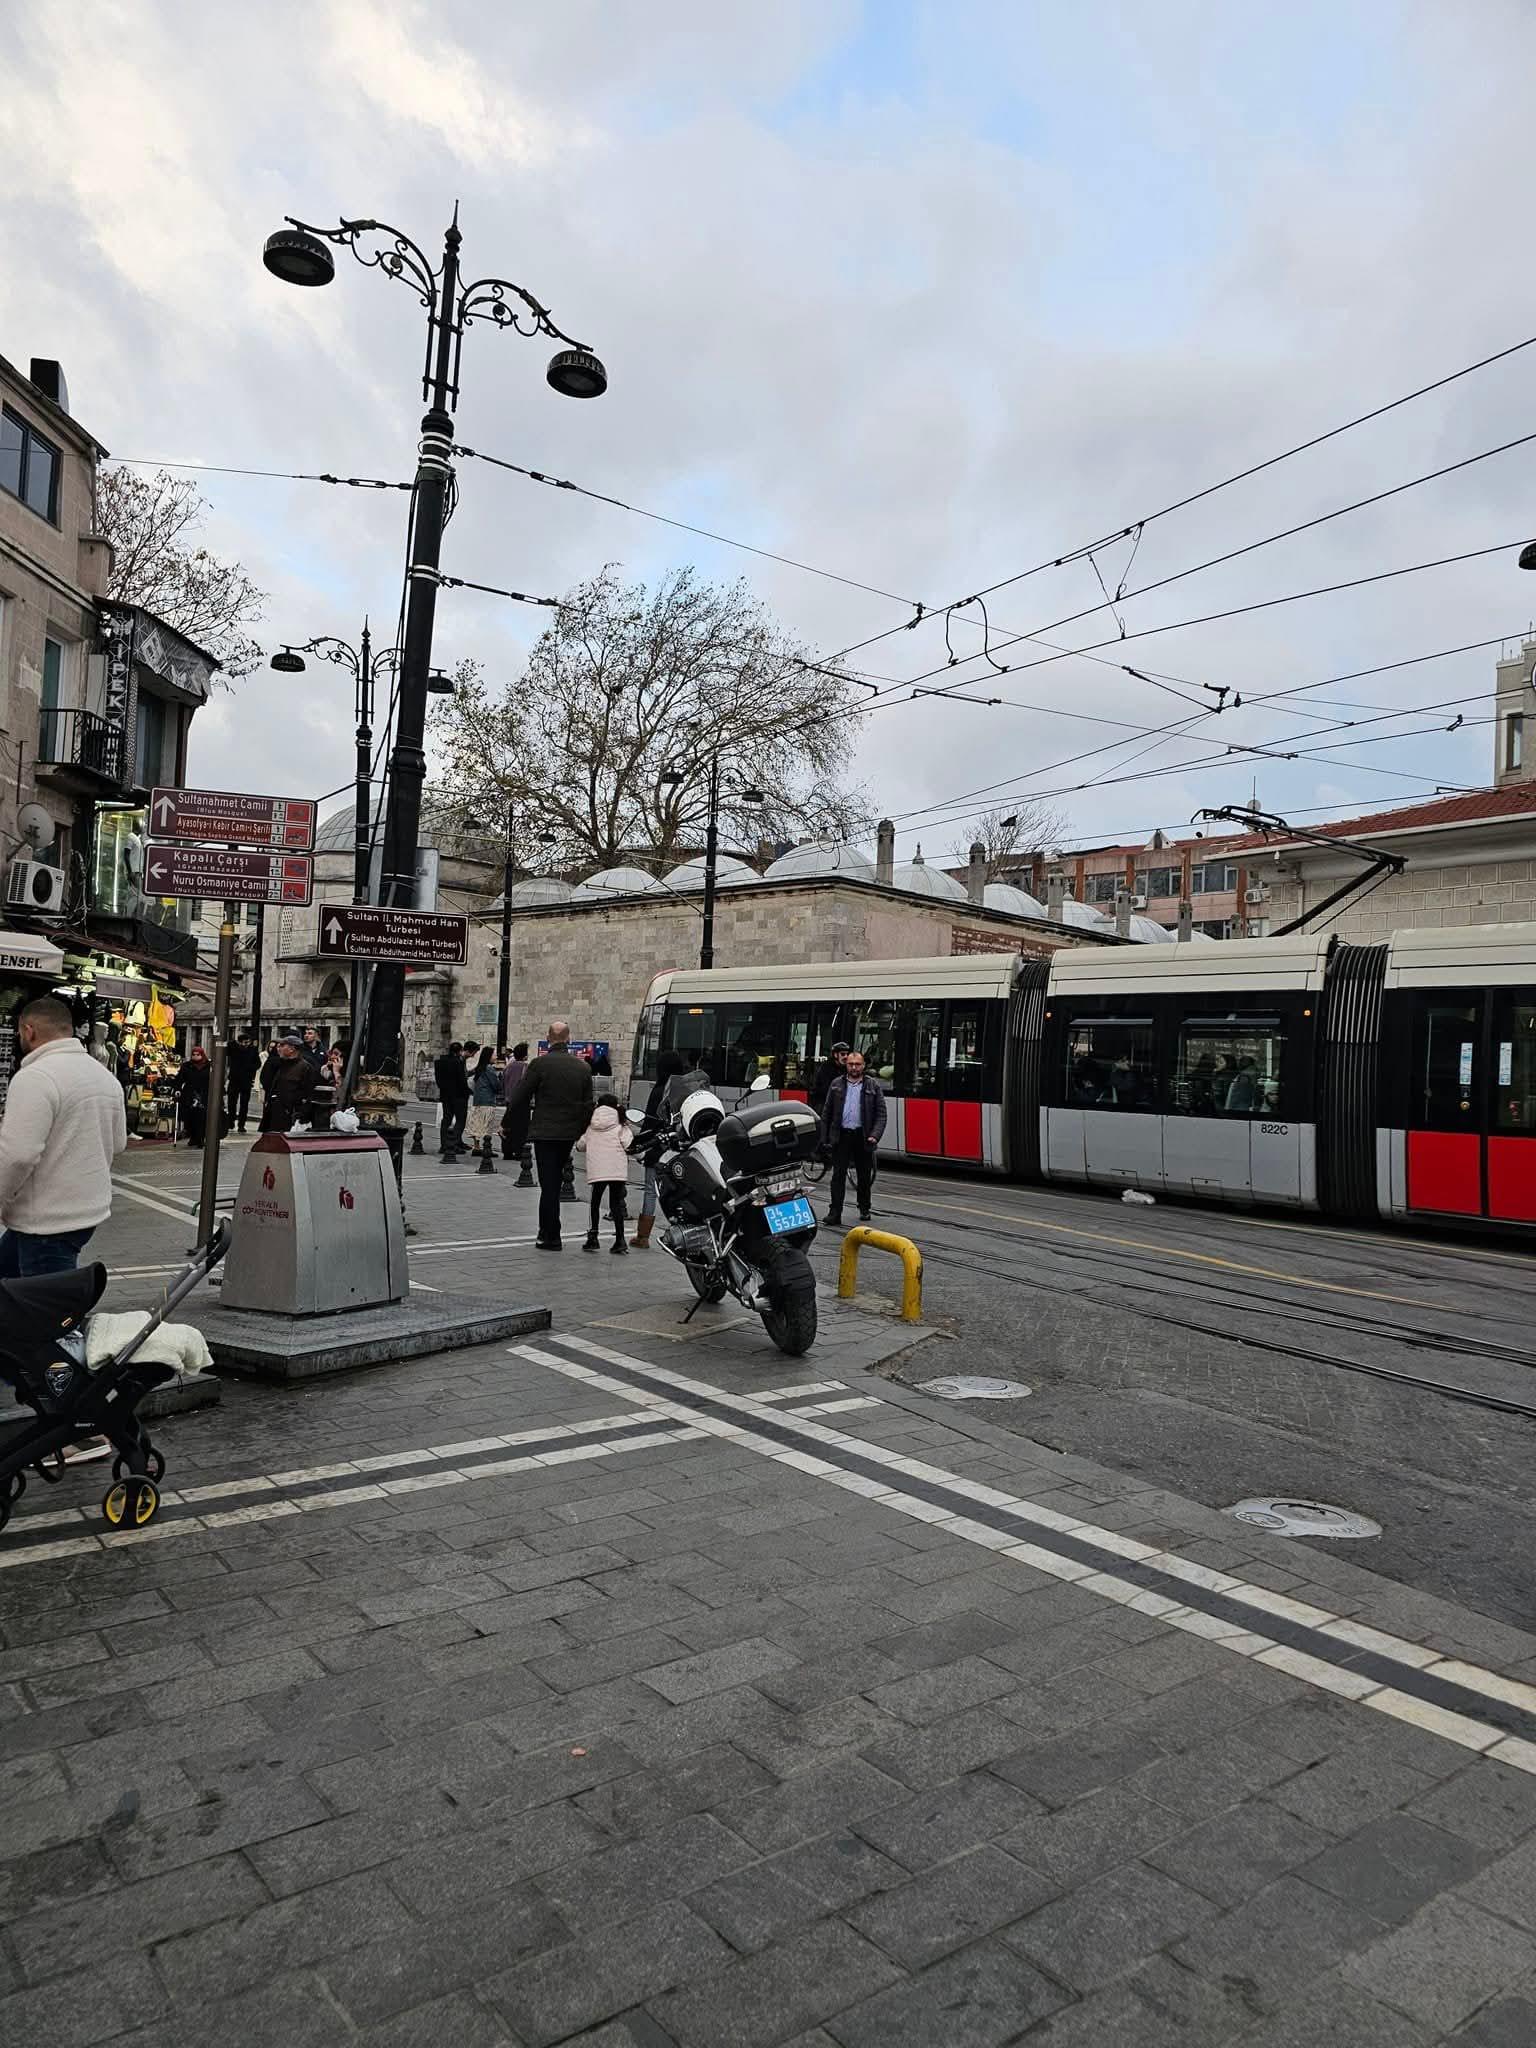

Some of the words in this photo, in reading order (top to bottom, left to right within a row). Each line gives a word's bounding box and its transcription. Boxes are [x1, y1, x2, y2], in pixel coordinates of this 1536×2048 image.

[177, 792, 238, 809] Sultanahmet
[240, 798, 267, 811] Camii
[174, 851, 213, 864] Kapalı
[217, 854, 249, 867] Çarşı
[172, 874, 194, 885] Nuru
[196, 876, 240, 890] Osmaniye
[241, 879, 267, 890] Camii
[347, 911, 379, 921] Sultan
[393, 915, 437, 926] Mahmud
[440, 919, 459, 928] Han
[385, 924, 421, 935] Türbesi
[377, 935, 413, 945] Abdülaziz
[415, 938, 430, 946] Han
[0, 954, 42, 968] ENSEL
[419, 950, 432, 958] Han
[1261, 1123, 1289, 1135] 822C
[767, 1207, 783, 1219] 34
[774, 1211, 810, 1231] 55229
